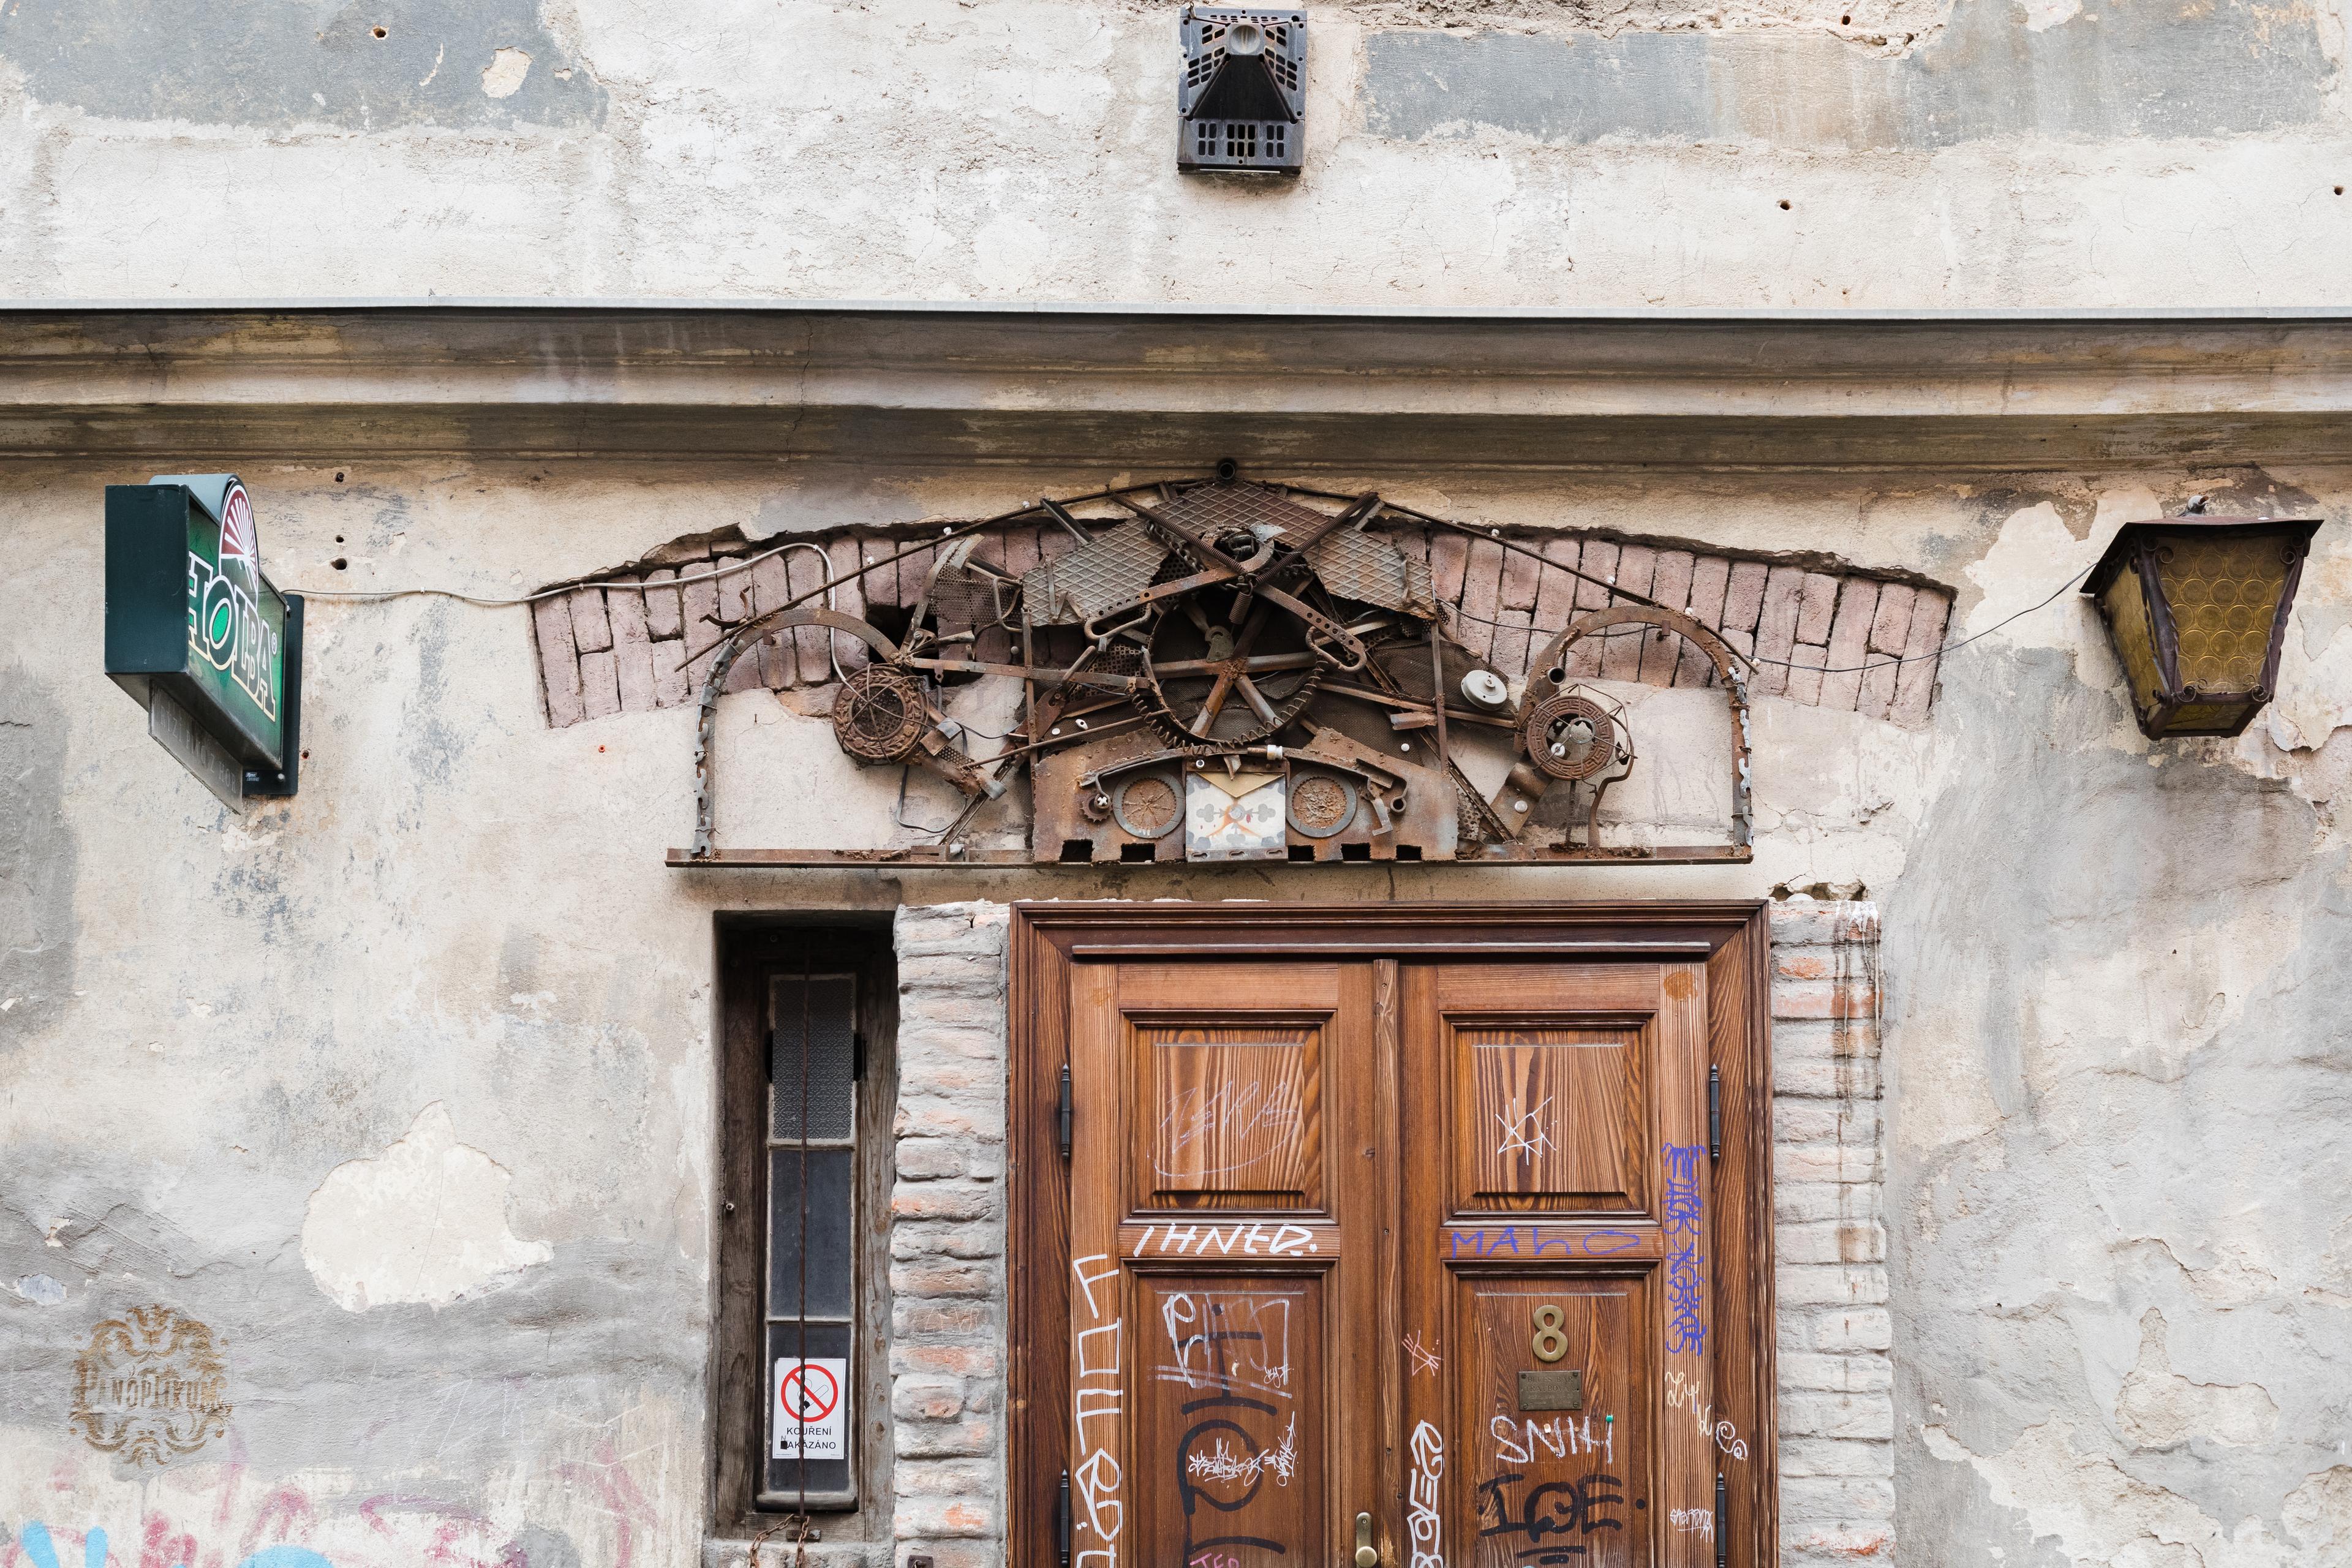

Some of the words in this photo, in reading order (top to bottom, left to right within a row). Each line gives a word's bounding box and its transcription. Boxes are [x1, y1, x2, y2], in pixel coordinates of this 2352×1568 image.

[189, 551, 276, 723] HOLBA
[1532, 1305, 1569, 1362] 8
[780, 1439, 837, 1450] AKÁZÁNO
[786, 1426, 832, 1435] KOUŘENÍ
